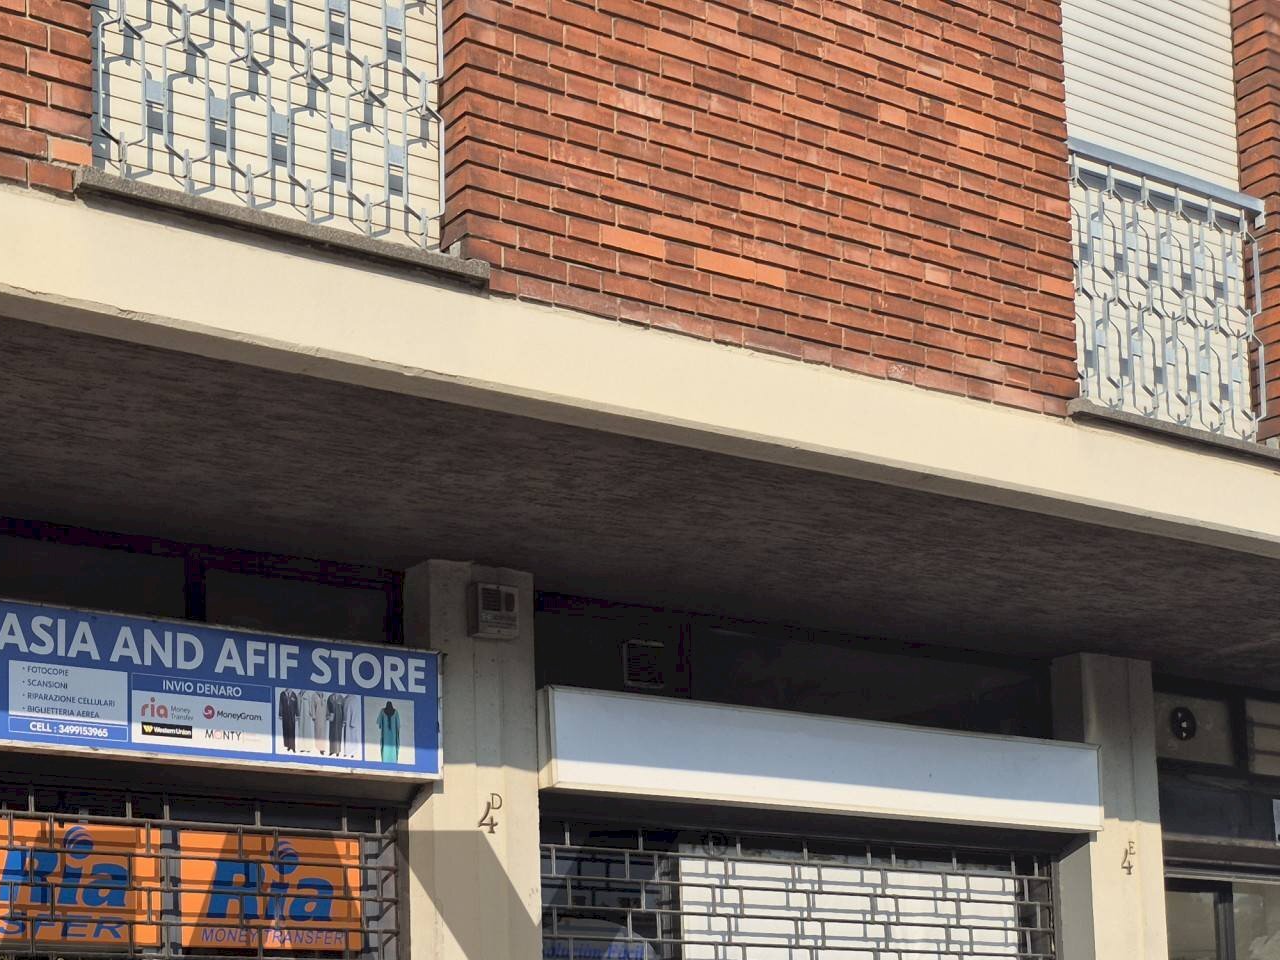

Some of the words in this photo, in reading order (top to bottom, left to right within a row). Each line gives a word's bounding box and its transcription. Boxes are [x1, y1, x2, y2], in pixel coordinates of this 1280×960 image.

[110, 626, 204, 671] AND
[214, 638, 300, 680] AFIF
[310, 647, 426, 694] STORE
[27, 666, 69, 677] FOTOCOPIE
[27, 679, 68, 689] SCANSIONI
[162, 680, 194, 692] INVIO
[196, 683, 242, 697] DENARO
[27, 692, 76, 704] RIPARAZIONE
[77, 697, 116, 707] CELLULARI
[27, 706, 75, 717] BIGLIETTERIA
[76, 710, 100, 719] AEREA
[141, 697, 169, 719] ria
[29, 722, 52, 732] CELL
[58, 724, 109, 737] 3499153965
[205, 729, 242, 741] MONTY
[207, 841, 334, 921] Ria
[201, 927, 258, 945] MONEY
[262, 929, 346, 946] TRANSFER
